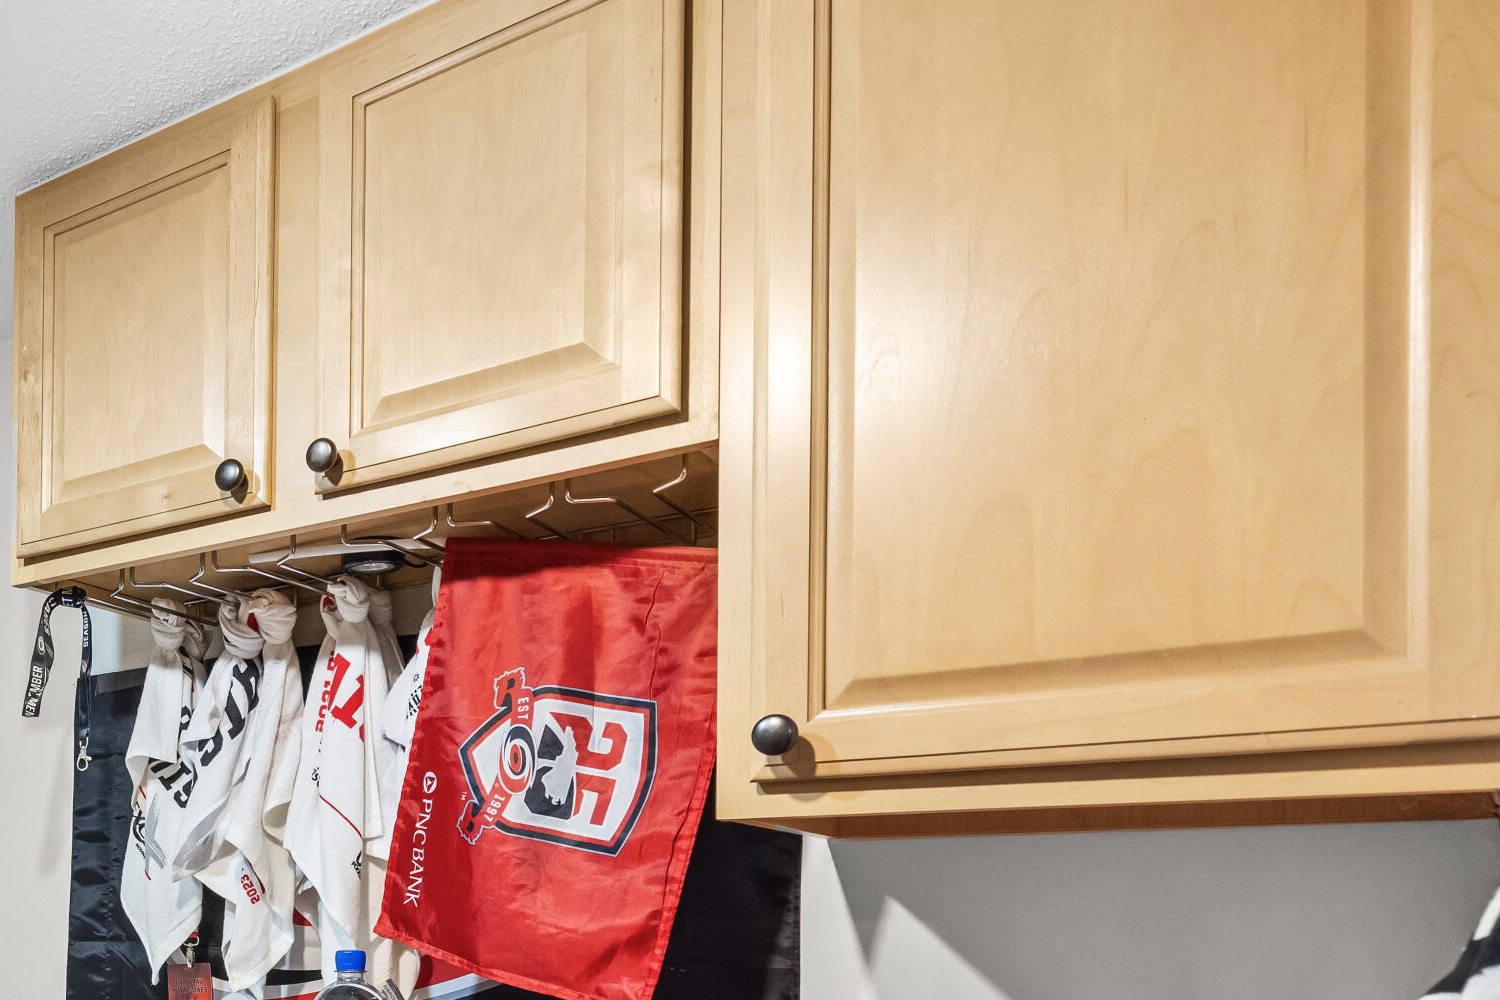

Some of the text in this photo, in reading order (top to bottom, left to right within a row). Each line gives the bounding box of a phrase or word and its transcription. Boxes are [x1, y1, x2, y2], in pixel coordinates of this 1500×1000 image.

[517, 696, 531, 720] EST
[524, 711, 629, 826] 25
[483, 793, 506, 822] 1997
[240, 873, 260, 905] 2023
